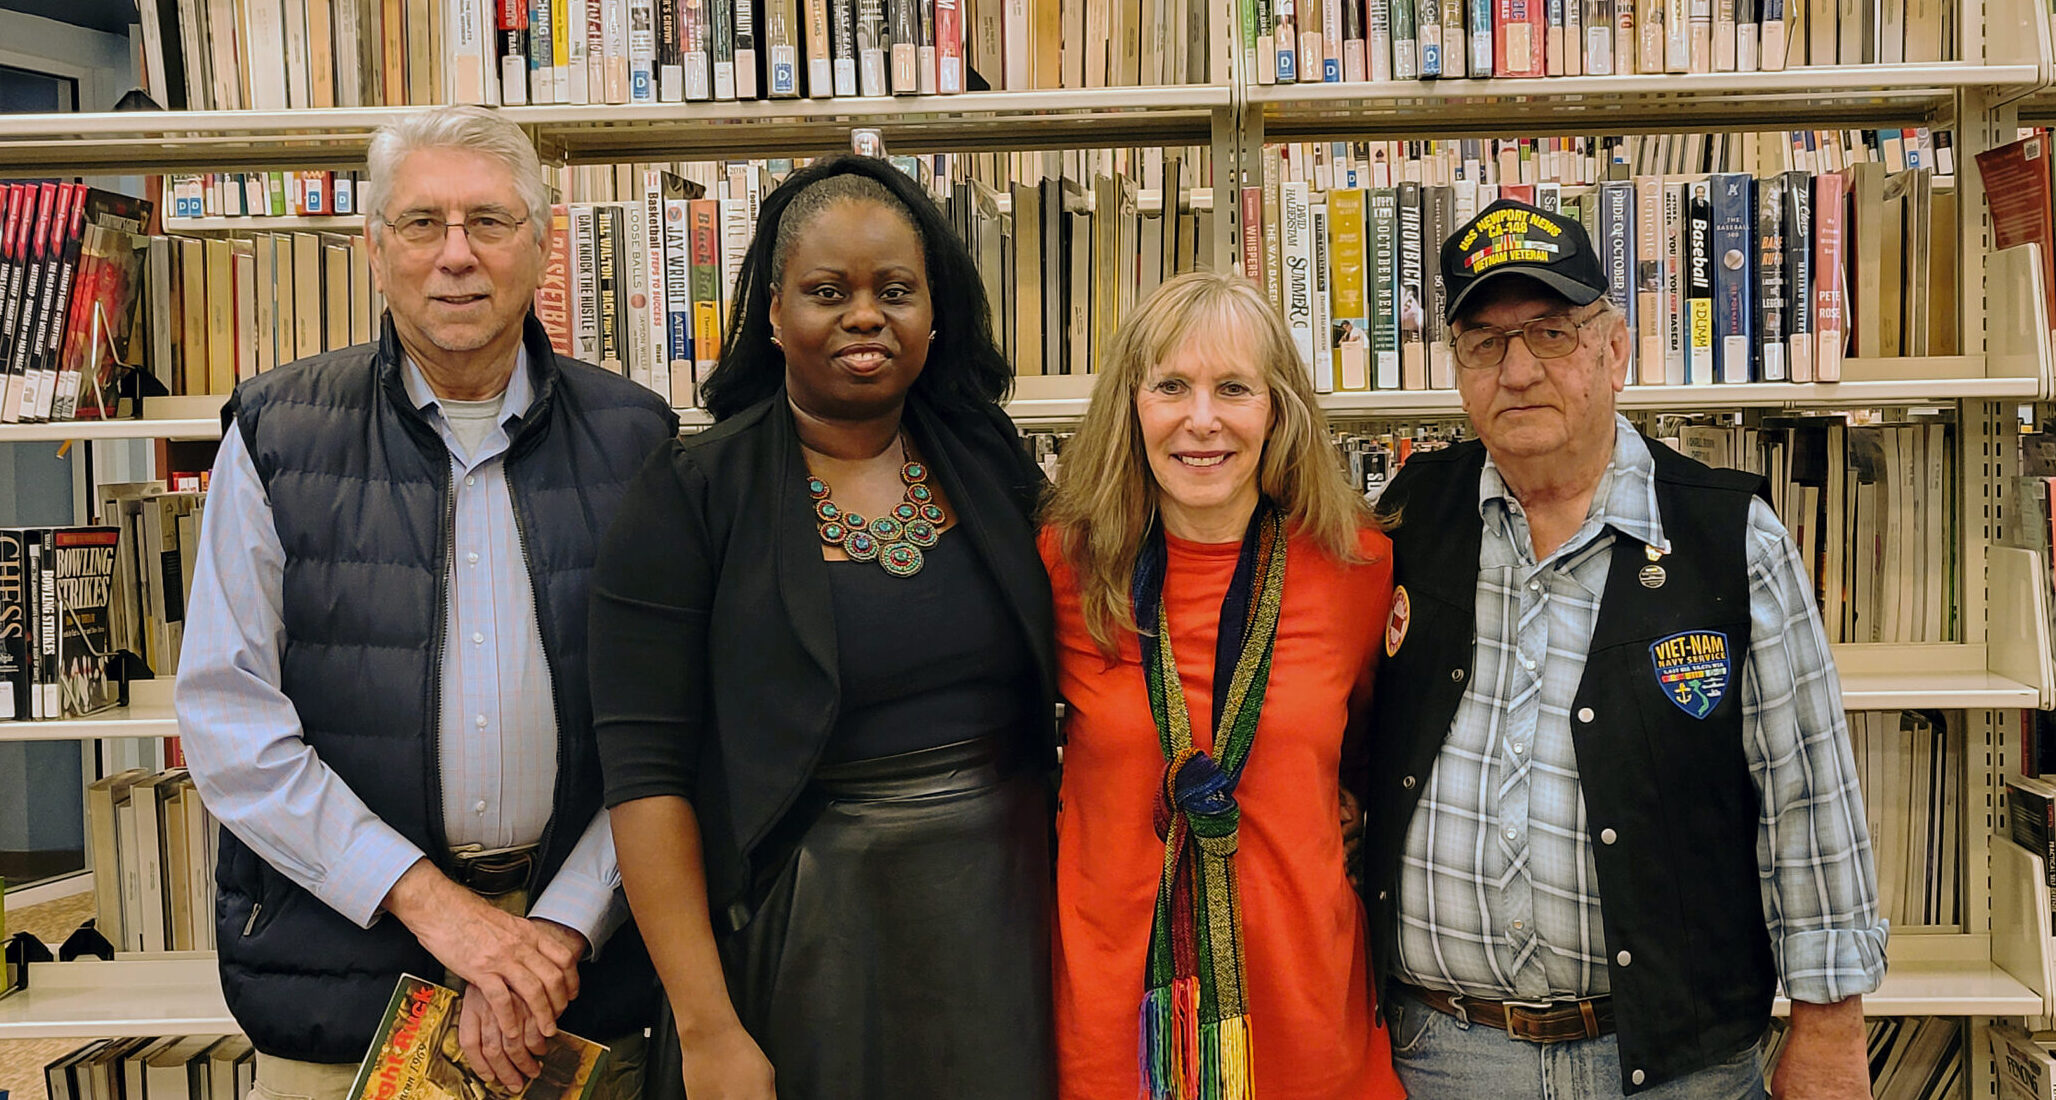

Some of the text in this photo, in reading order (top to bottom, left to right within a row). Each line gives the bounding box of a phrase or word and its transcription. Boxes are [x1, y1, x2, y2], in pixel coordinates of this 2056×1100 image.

[664, 14, 673, 44] CROWN
[841, 5, 851, 29] LAST
[1281, 57, 1290, 68] D
[1326, 65, 1336, 76] D
[1427, 50, 1437, 62] D
[636, 77, 646, 89] D
[778, 70, 788, 81] D
[749, 189, 758, 222] Football
[1286, 188, 1297, 247] HALBERSTAM
[1296, 204, 1307, 230] DAVID
[1608, 189, 1628, 221] PRIDE
[1644, 180, 1660, 257] Clemente
[599, 213, 612, 236] BILL
[647, 192, 659, 249] Basketball
[727, 208, 746, 238] TALL
[1267, 222, 1277, 243] THE
[1459, 208, 1562, 251] USS NEWPORT NEWS
[1487, 221, 1528, 239] CA-148
[1610, 222, 1625, 238] OF
[600, 238, 614, 280] WALTON
[630, 208, 642, 289] LOOSE BALLS
[697, 212, 714, 309] Black Ball
[1245, 224, 1258, 278] WHISPERS
[1268, 246, 1278, 267] WAY
[1376, 225, 1392, 284] OCTOBER
[1402, 205, 1420, 288] THROWBACK
[1668, 235, 1677, 256] YOU
[1691, 218, 1709, 288] Baseball
[1761, 252, 1783, 266] RUTH
[577, 214, 595, 331] CAN'T KNOCK THE HUSTLE
[651, 251, 661, 277] STEPS
[667, 226, 686, 305] JAY WRIGHT
[1472, 249, 1549, 275] VIETNAM VETERAN
[1612, 239, 1626, 290] OCTOBER
[652, 278, 662, 289] TO
[1286, 256, 1309, 320] SUMMER
[1669, 274, 1678, 294] YOU
[1797, 261, 1806, 332] MARIANO RIVERA
[1819, 290, 1841, 302] PETE
[602, 290, 615, 315] BACK
[653, 291, 663, 328] SUCCESS
[1377, 289, 1393, 316] MEN
[1819, 307, 1841, 319] ROSE
[56, 547, 114, 579] BOWLING
[0, 535, 23, 640] CHESS
[56, 576, 111, 611] STRIKES
[41, 570, 56, 656] BOWLING STRIKES
[1654, 635, 1725, 660] VIET-NAM
[1658, 657, 1684, 668] NAVY
[1686, 652, 1726, 664] SERVICE
[392, 985, 435, 1051] Ruck
[409, 1043, 428, 1073] 1969
[2005, 1055, 2039, 1095] FENCING
